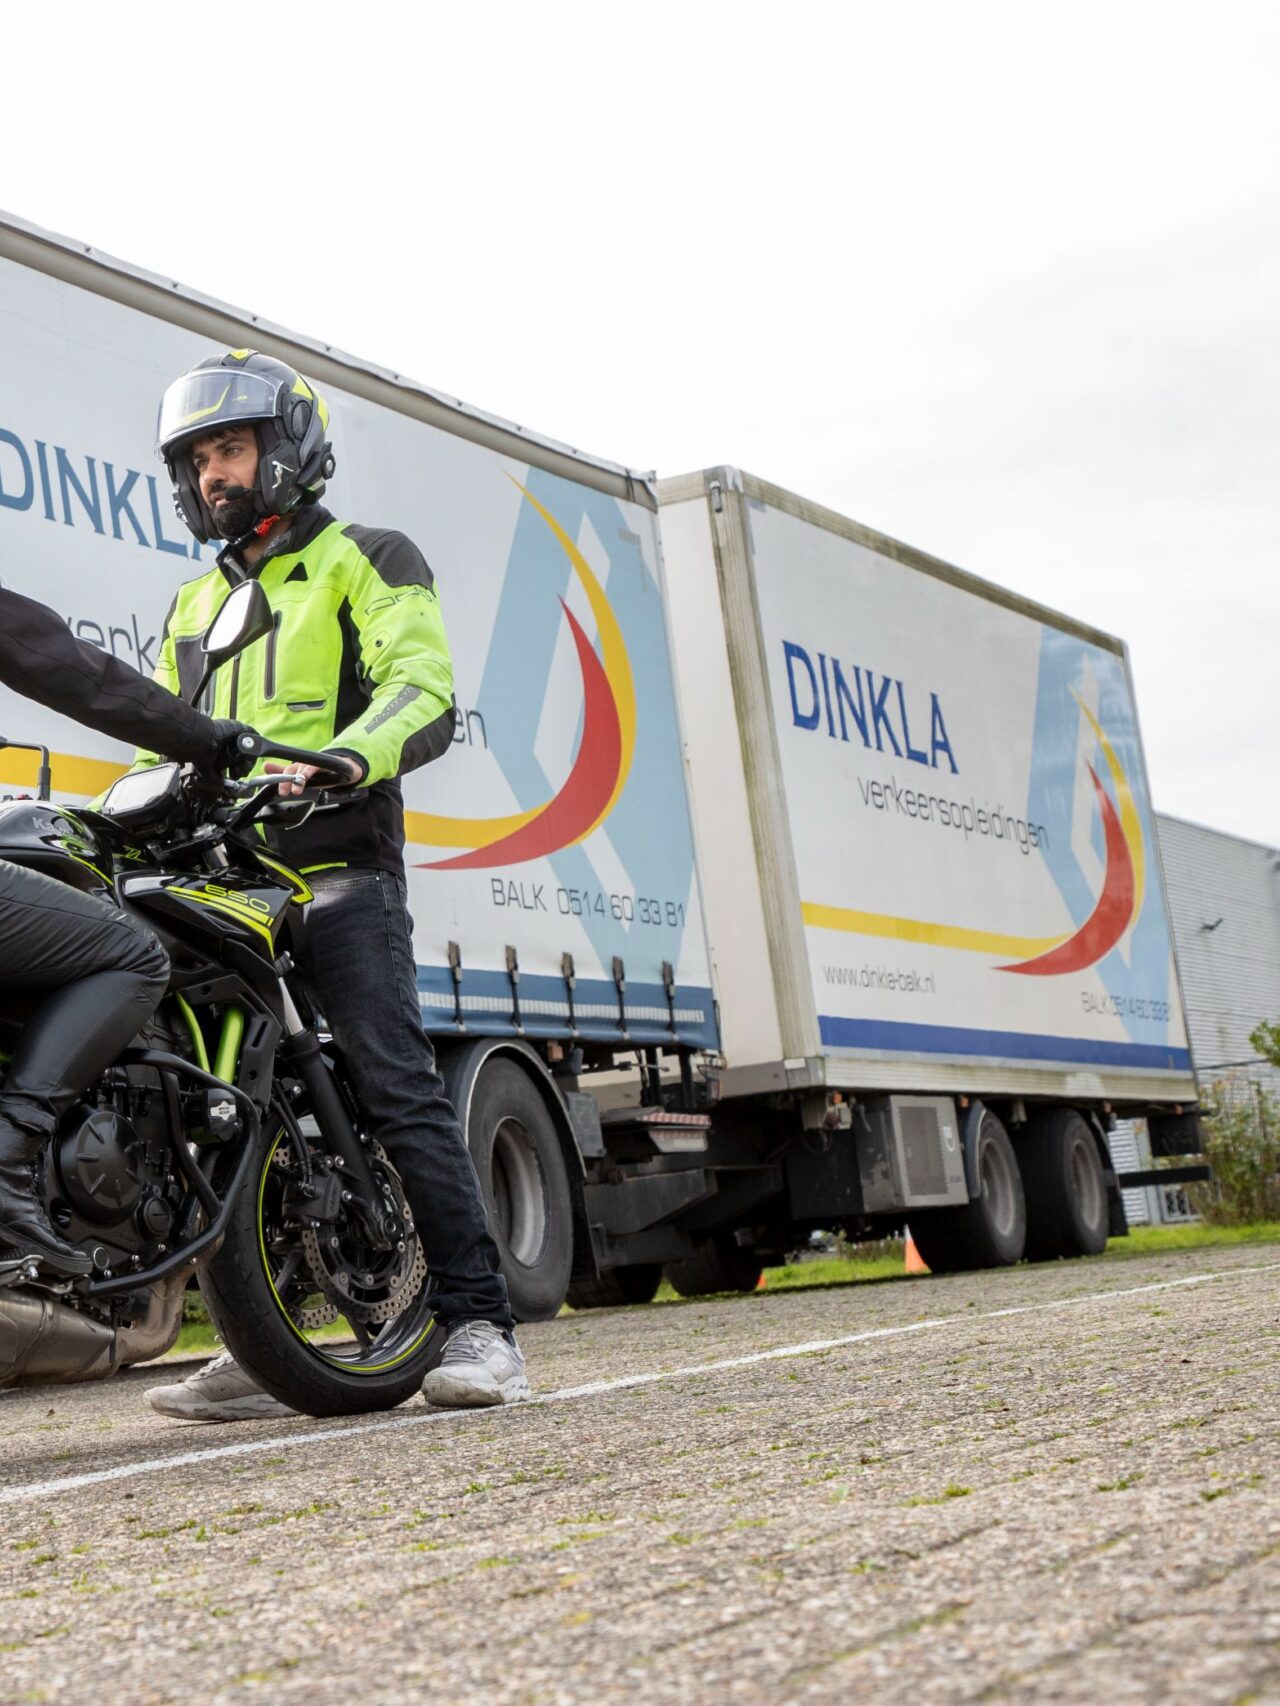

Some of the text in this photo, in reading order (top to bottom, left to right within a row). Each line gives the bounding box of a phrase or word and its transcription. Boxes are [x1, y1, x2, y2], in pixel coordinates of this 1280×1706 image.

[782, 640, 960, 775] DINKLA
[857, 775, 1050, 855] verkeersopleidingen
[204, 883, 271, 914] 650
[491, 878, 685, 928] BALK 0514 60 33 81
[822, 963, 936, 995] www.dinkla-balk.nl
